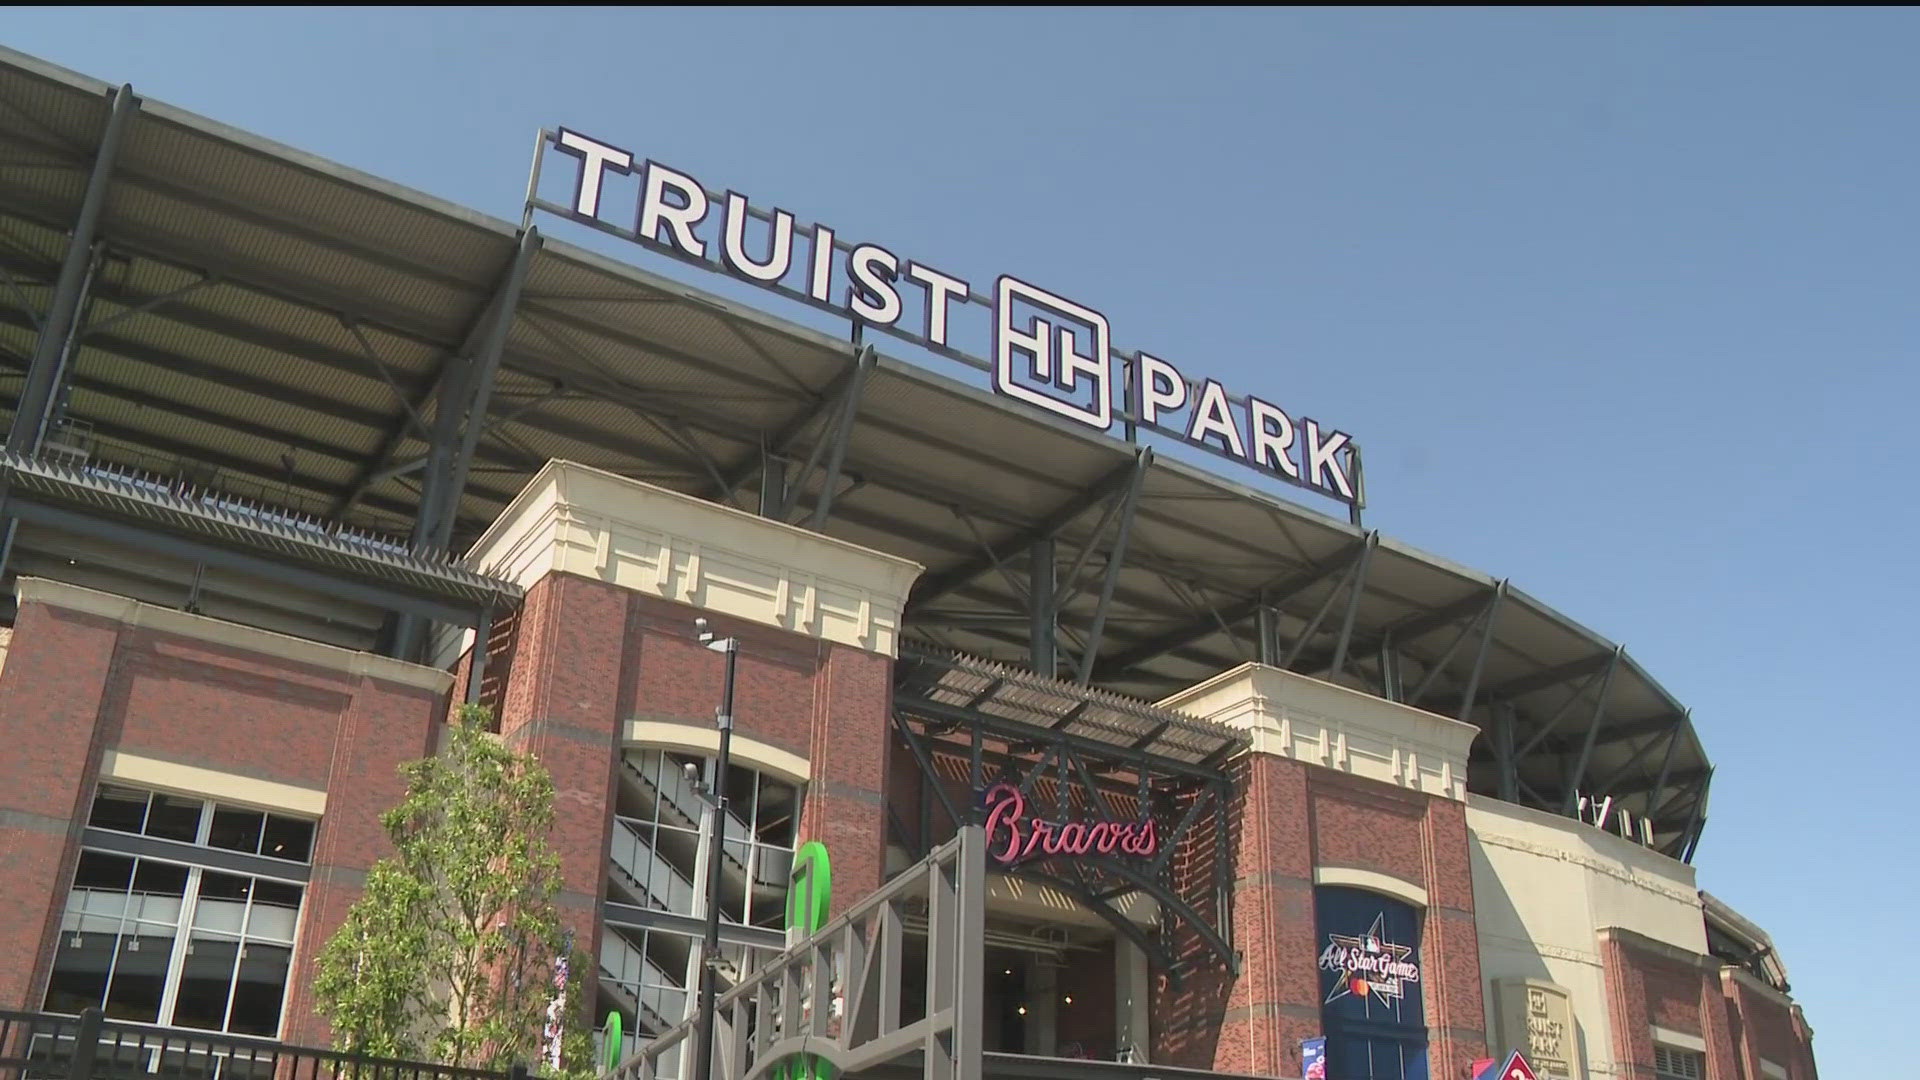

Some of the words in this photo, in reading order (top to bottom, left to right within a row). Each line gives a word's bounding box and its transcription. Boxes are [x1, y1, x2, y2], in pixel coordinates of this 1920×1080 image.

[554, 126, 969, 347] TRUIST
[1135, 350, 1353, 499] PARK
[985, 783, 1157, 864] Braves
[1319, 943, 1347, 968] All
[1347, 947, 1379, 972] Star
[1378, 953, 1418, 980] Game
[1522, 1017, 1563, 1040] RUIST
